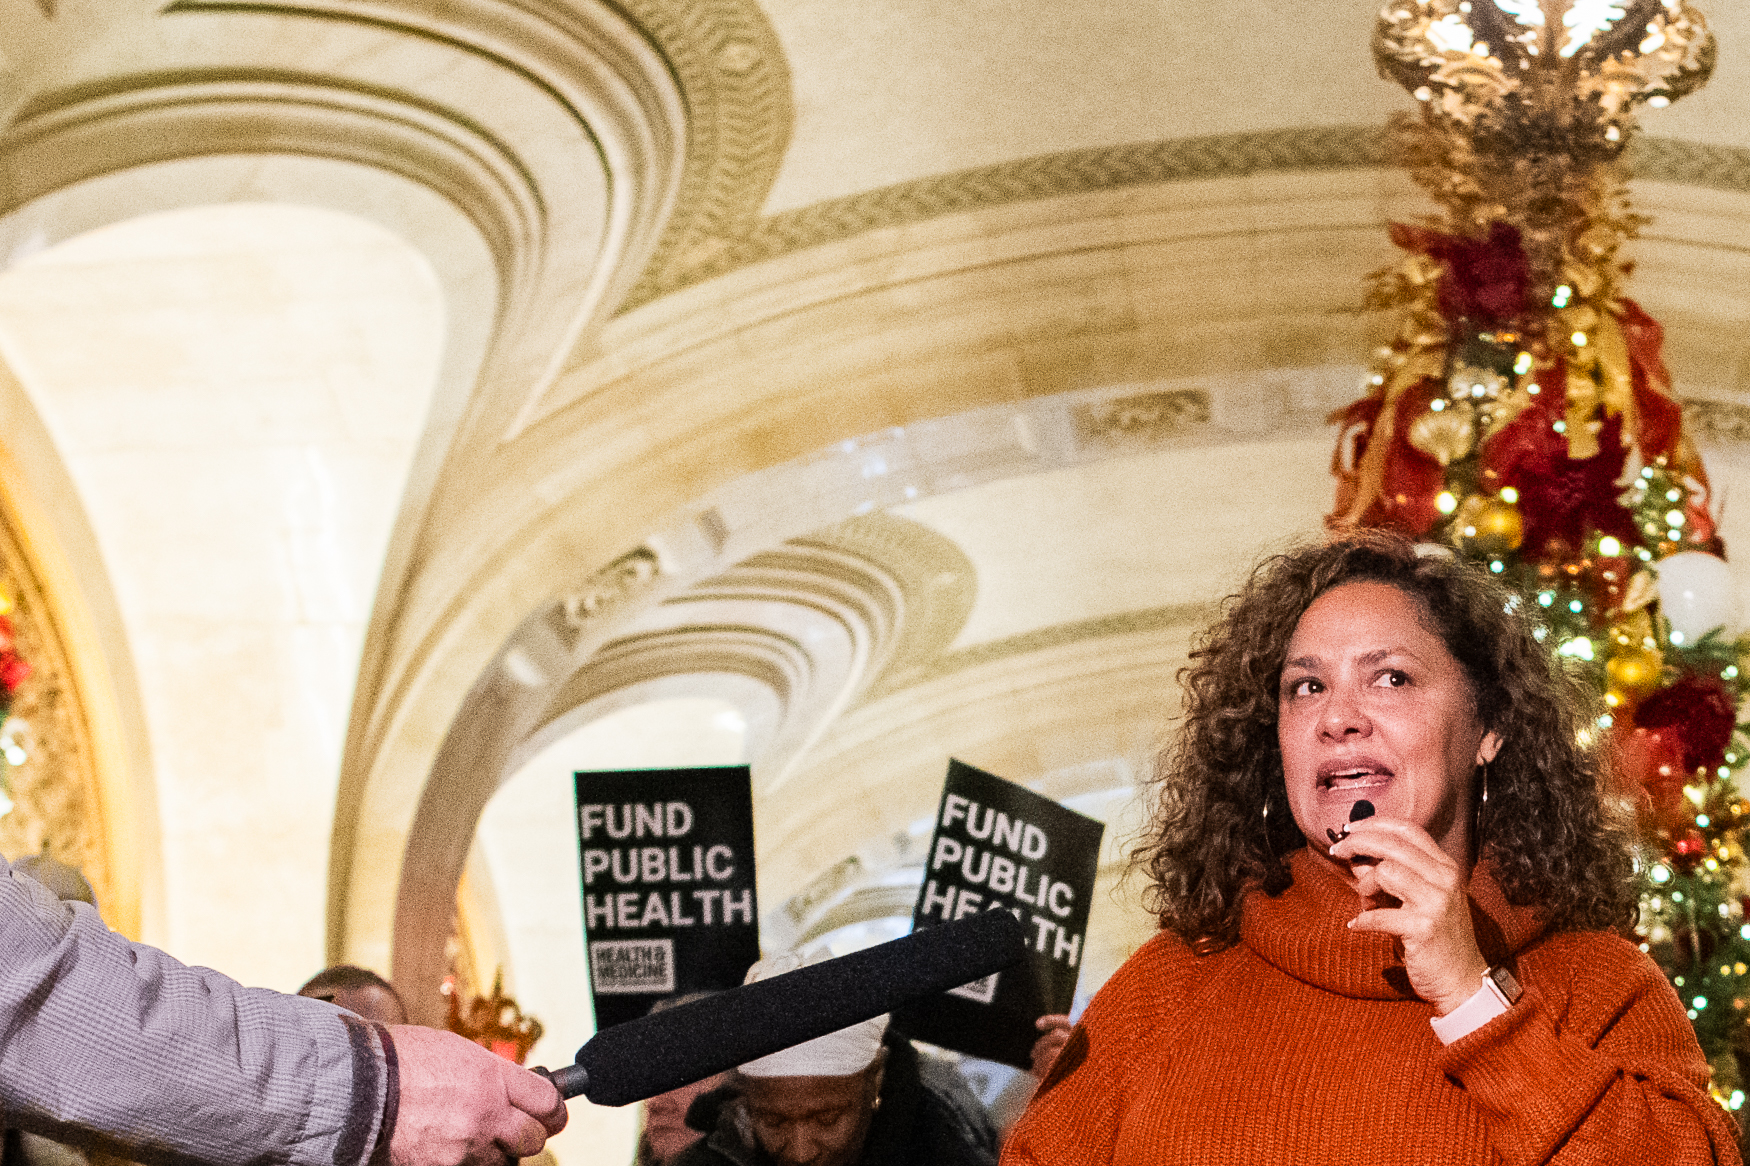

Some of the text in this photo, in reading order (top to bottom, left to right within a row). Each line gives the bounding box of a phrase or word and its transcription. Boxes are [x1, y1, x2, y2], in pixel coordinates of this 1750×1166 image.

[581, 801, 694, 839] FUND
[942, 794, 1048, 860] FUND
[583, 844, 734, 884] PUBLIC
[933, 836, 1074, 917] PUBLIC
[586, 889, 752, 928] HEALTH
[922, 879, 1080, 967] HETH
